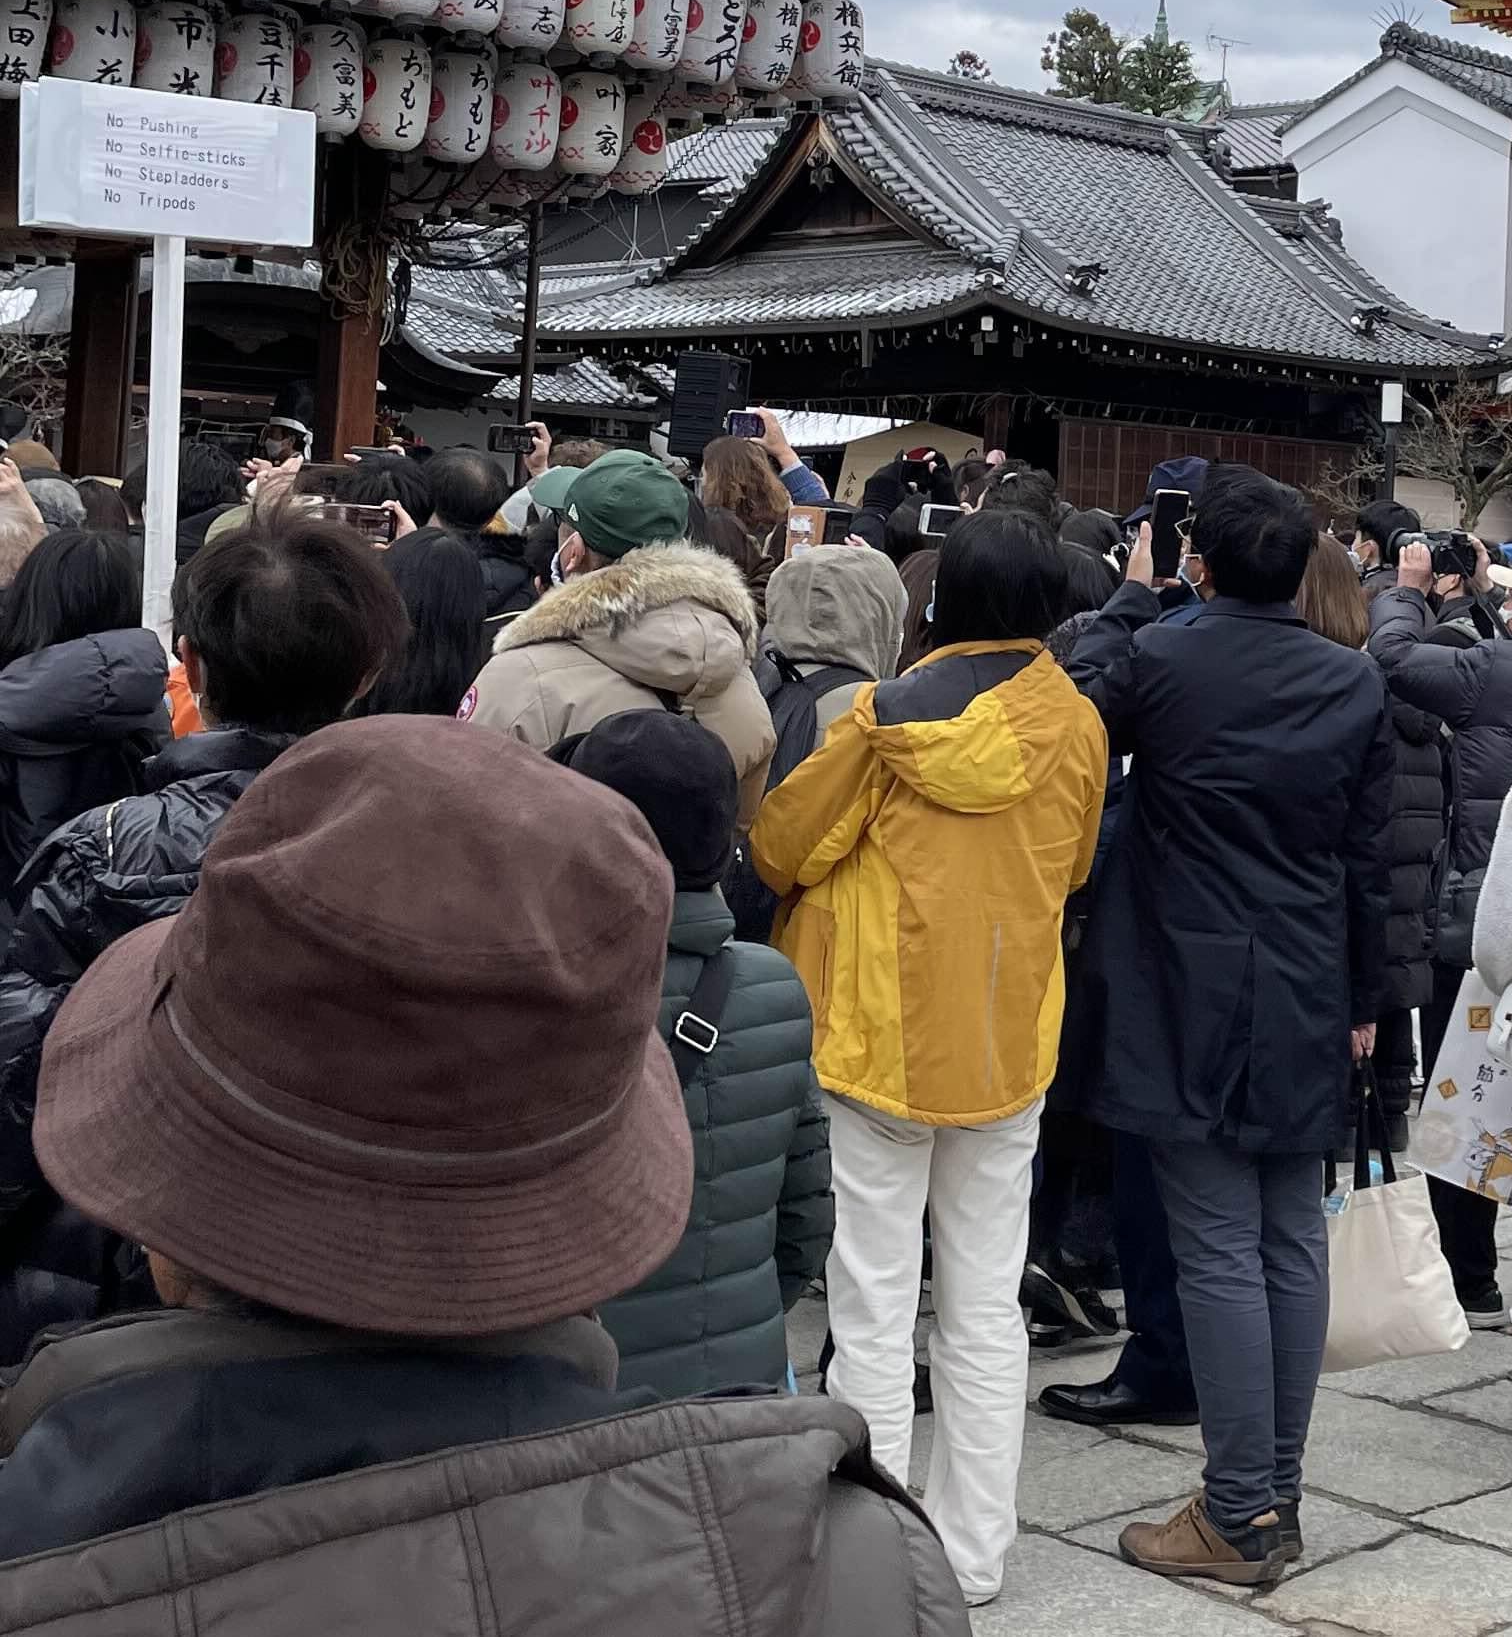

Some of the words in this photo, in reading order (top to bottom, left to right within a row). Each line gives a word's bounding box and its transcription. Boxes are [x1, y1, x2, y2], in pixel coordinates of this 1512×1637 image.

[395, 49, 422, 138] ちもと
[464, 63, 489, 153] ちもと
[106, 113, 124, 128] No
[140, 117, 199, 139] Pushing
[595, 83, 621, 157] 叶家
[105, 138, 123, 153] No
[139, 142, 246, 167] Selfie-sticks
[104, 162, 122, 178] No
[138, 166, 230, 189] Stepladders
[104, 188, 121, 203] No
[138, 192, 196, 211] Tripods
